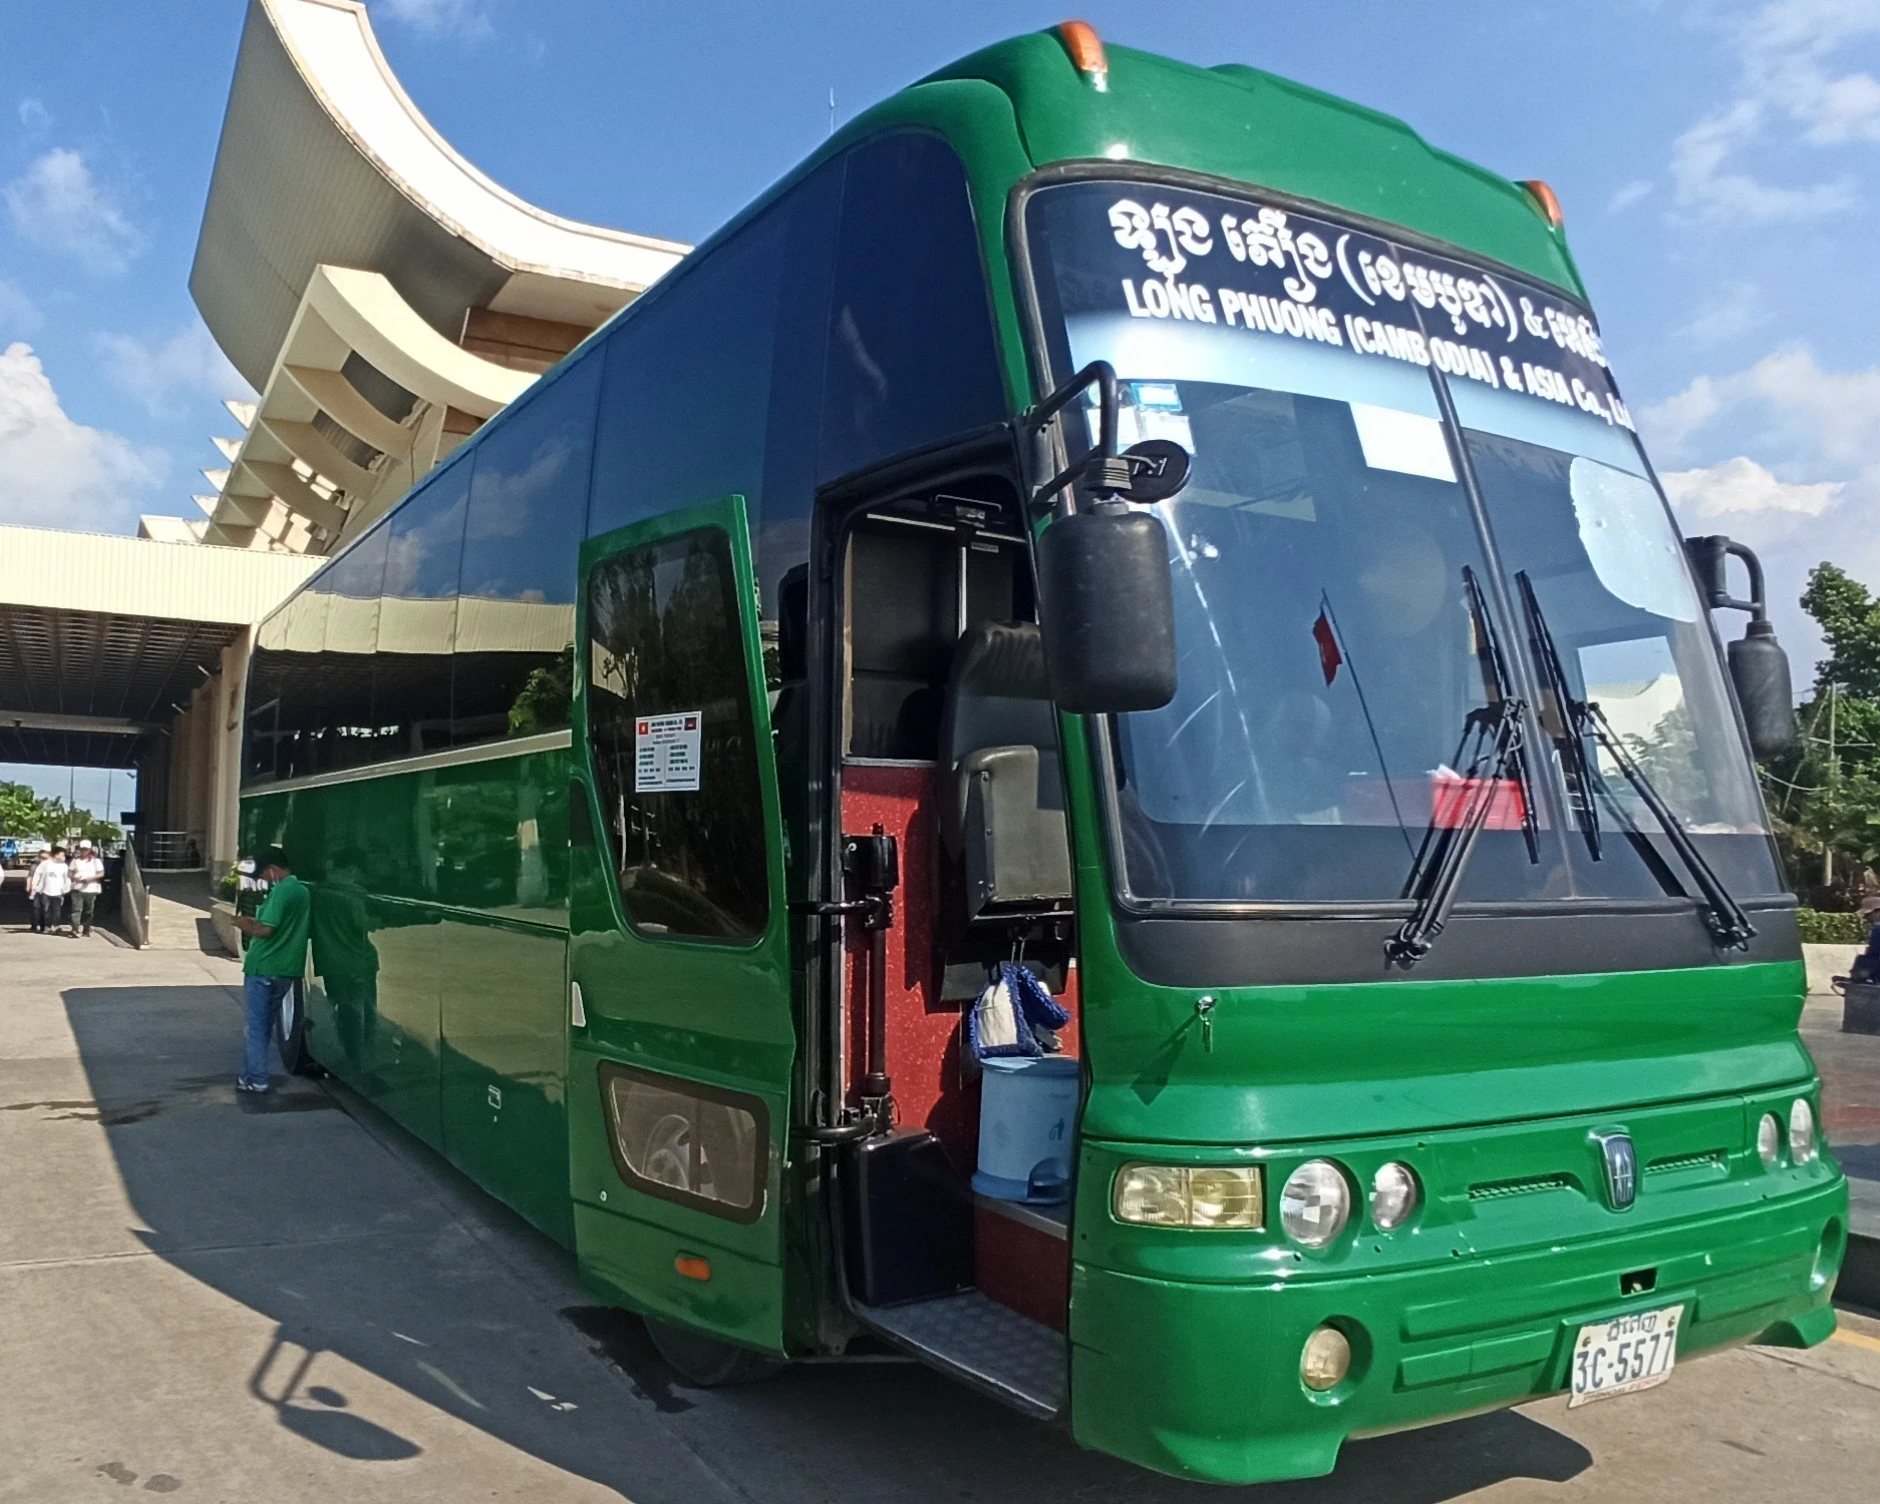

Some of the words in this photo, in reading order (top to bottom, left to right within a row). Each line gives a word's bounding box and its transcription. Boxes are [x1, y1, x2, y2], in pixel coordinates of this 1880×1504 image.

[1121, 278, 1217, 324] LONG
[1218, 288, 1343, 346] PHUONG
[1500, 355, 1524, 392] &
[1522, 362, 1575, 407] ASIA
[1519, 296, 1549, 339] &
[1575, 1329, 1675, 1394] 3C-5577
